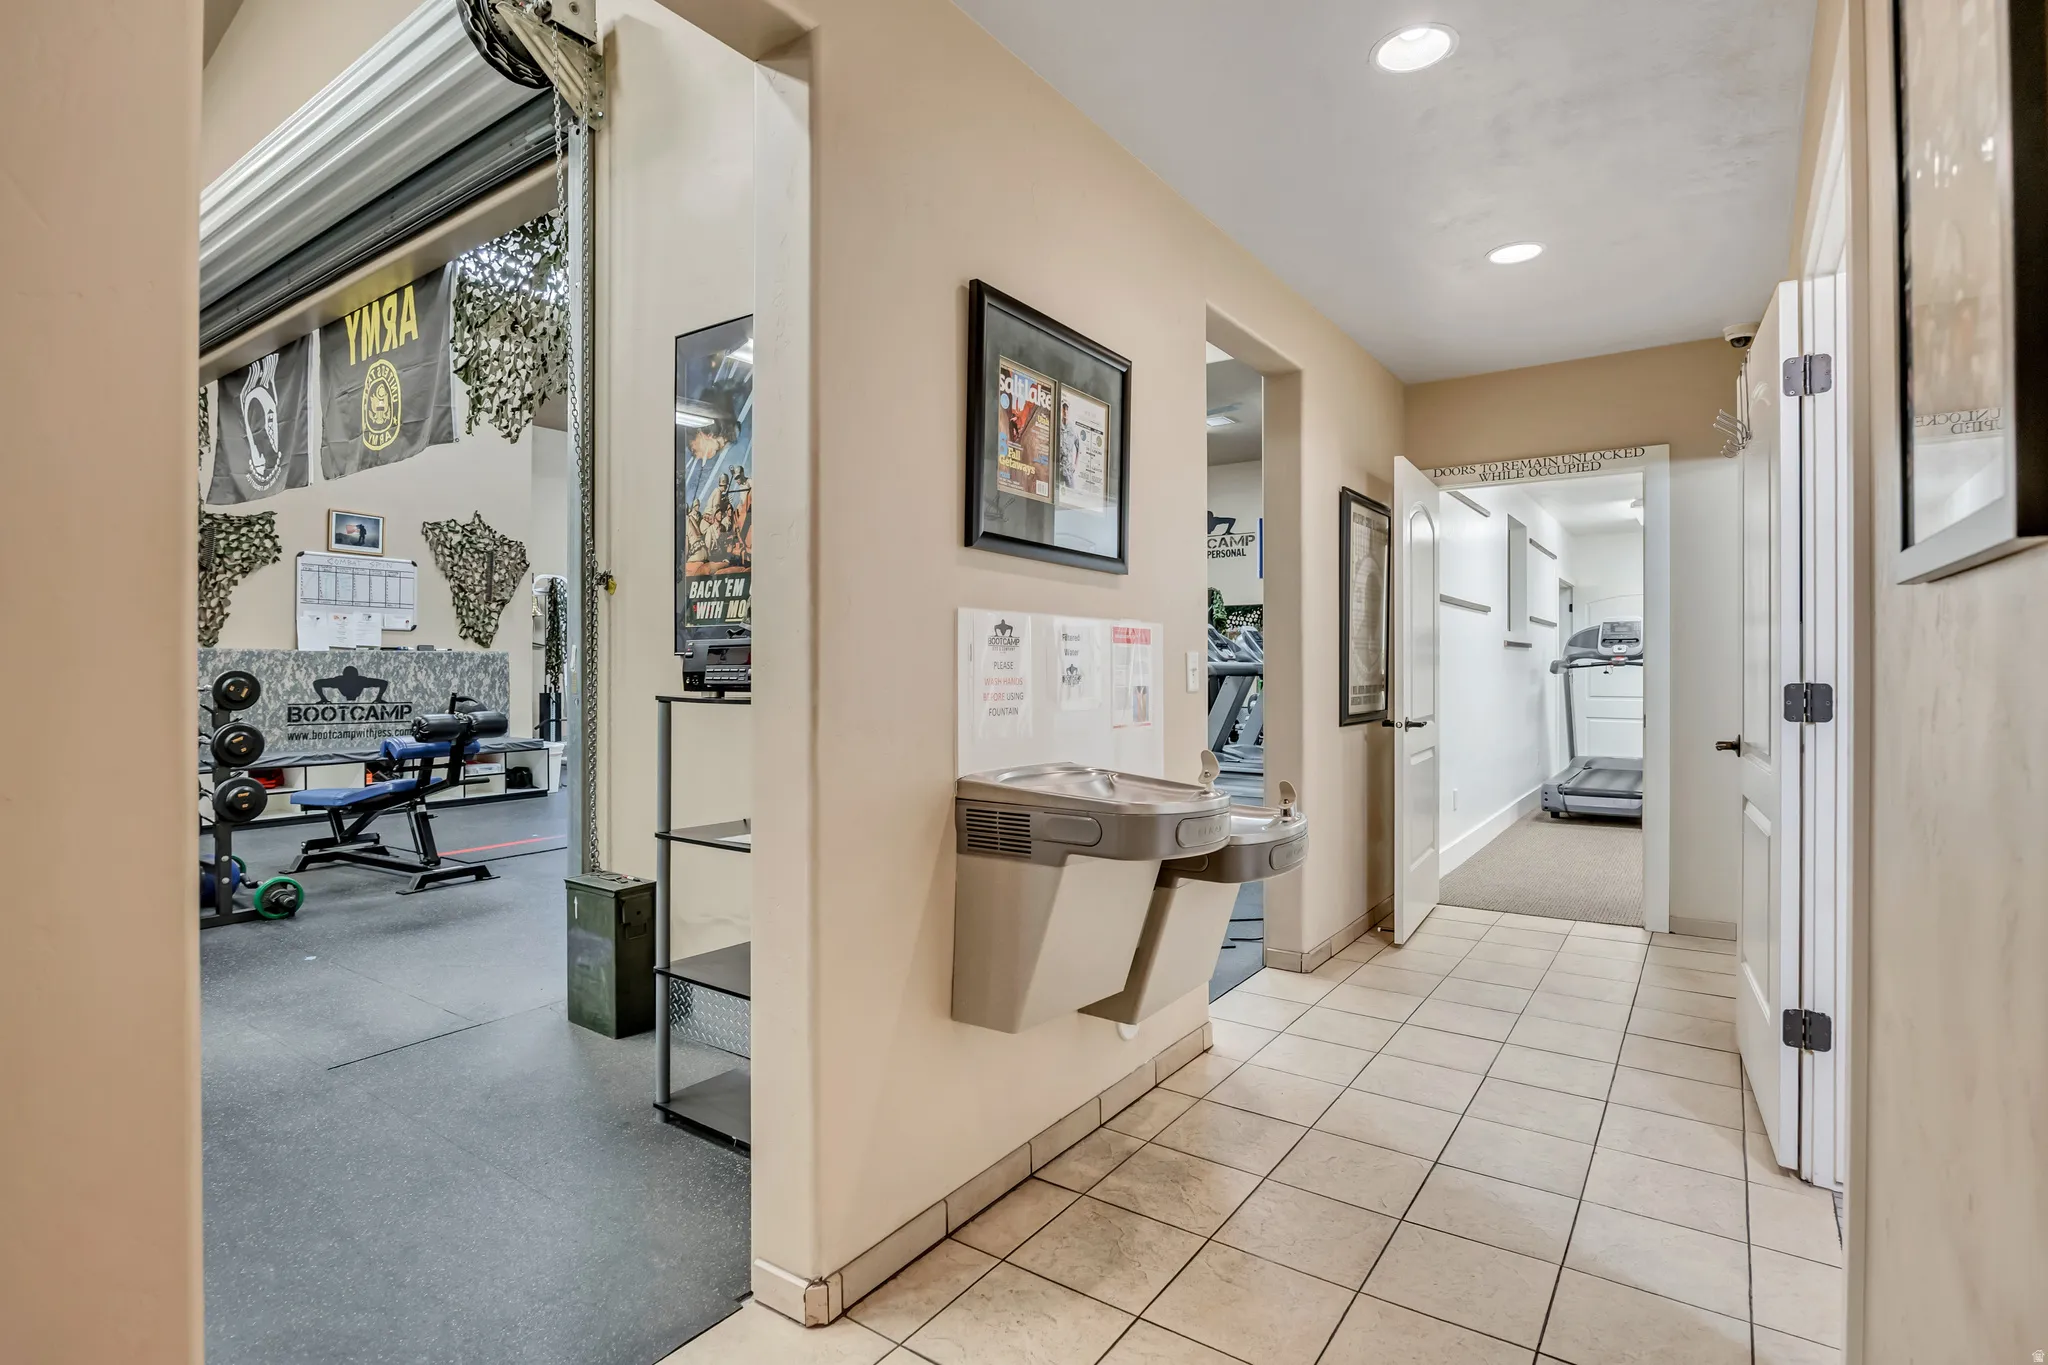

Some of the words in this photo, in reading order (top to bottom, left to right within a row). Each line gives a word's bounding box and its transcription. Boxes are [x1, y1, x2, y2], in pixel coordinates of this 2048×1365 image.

[1008, 447, 1021, 461] Fall
[999, 454, 1036, 475] Getaways
[1433, 465, 1476, 478] DOORS
[1480, 463, 1499, 474] TO
[1501, 457, 1559, 471] REMAIN
[1561, 447, 1646, 465] UNLOCKED
[1479, 469, 1525, 482] WHILE
[1528, 461, 1602, 478] OCCUPIED
[1207, 535, 1256, 549] CAMP
[1207, 548, 1247, 559] PERSONAL
[689, 580, 722, 599] BACK
[724, 577, 746, 597] 'EM
[696, 601, 724, 619] WITH
[988, 638, 1020, 646] BOOTCAMP
[993, 661, 1014, 670] PLEASE
[984, 678, 1002, 686] WASH
[1003, 678, 1023, 686] HANDS
[1006, 692, 1024, 701] USING
[287, 704, 412, 723] BOOTCAMP
[989, 707, 1019, 717] FOUNTAIN
[287, 728, 412, 741] www.bootcampwithjess.com
